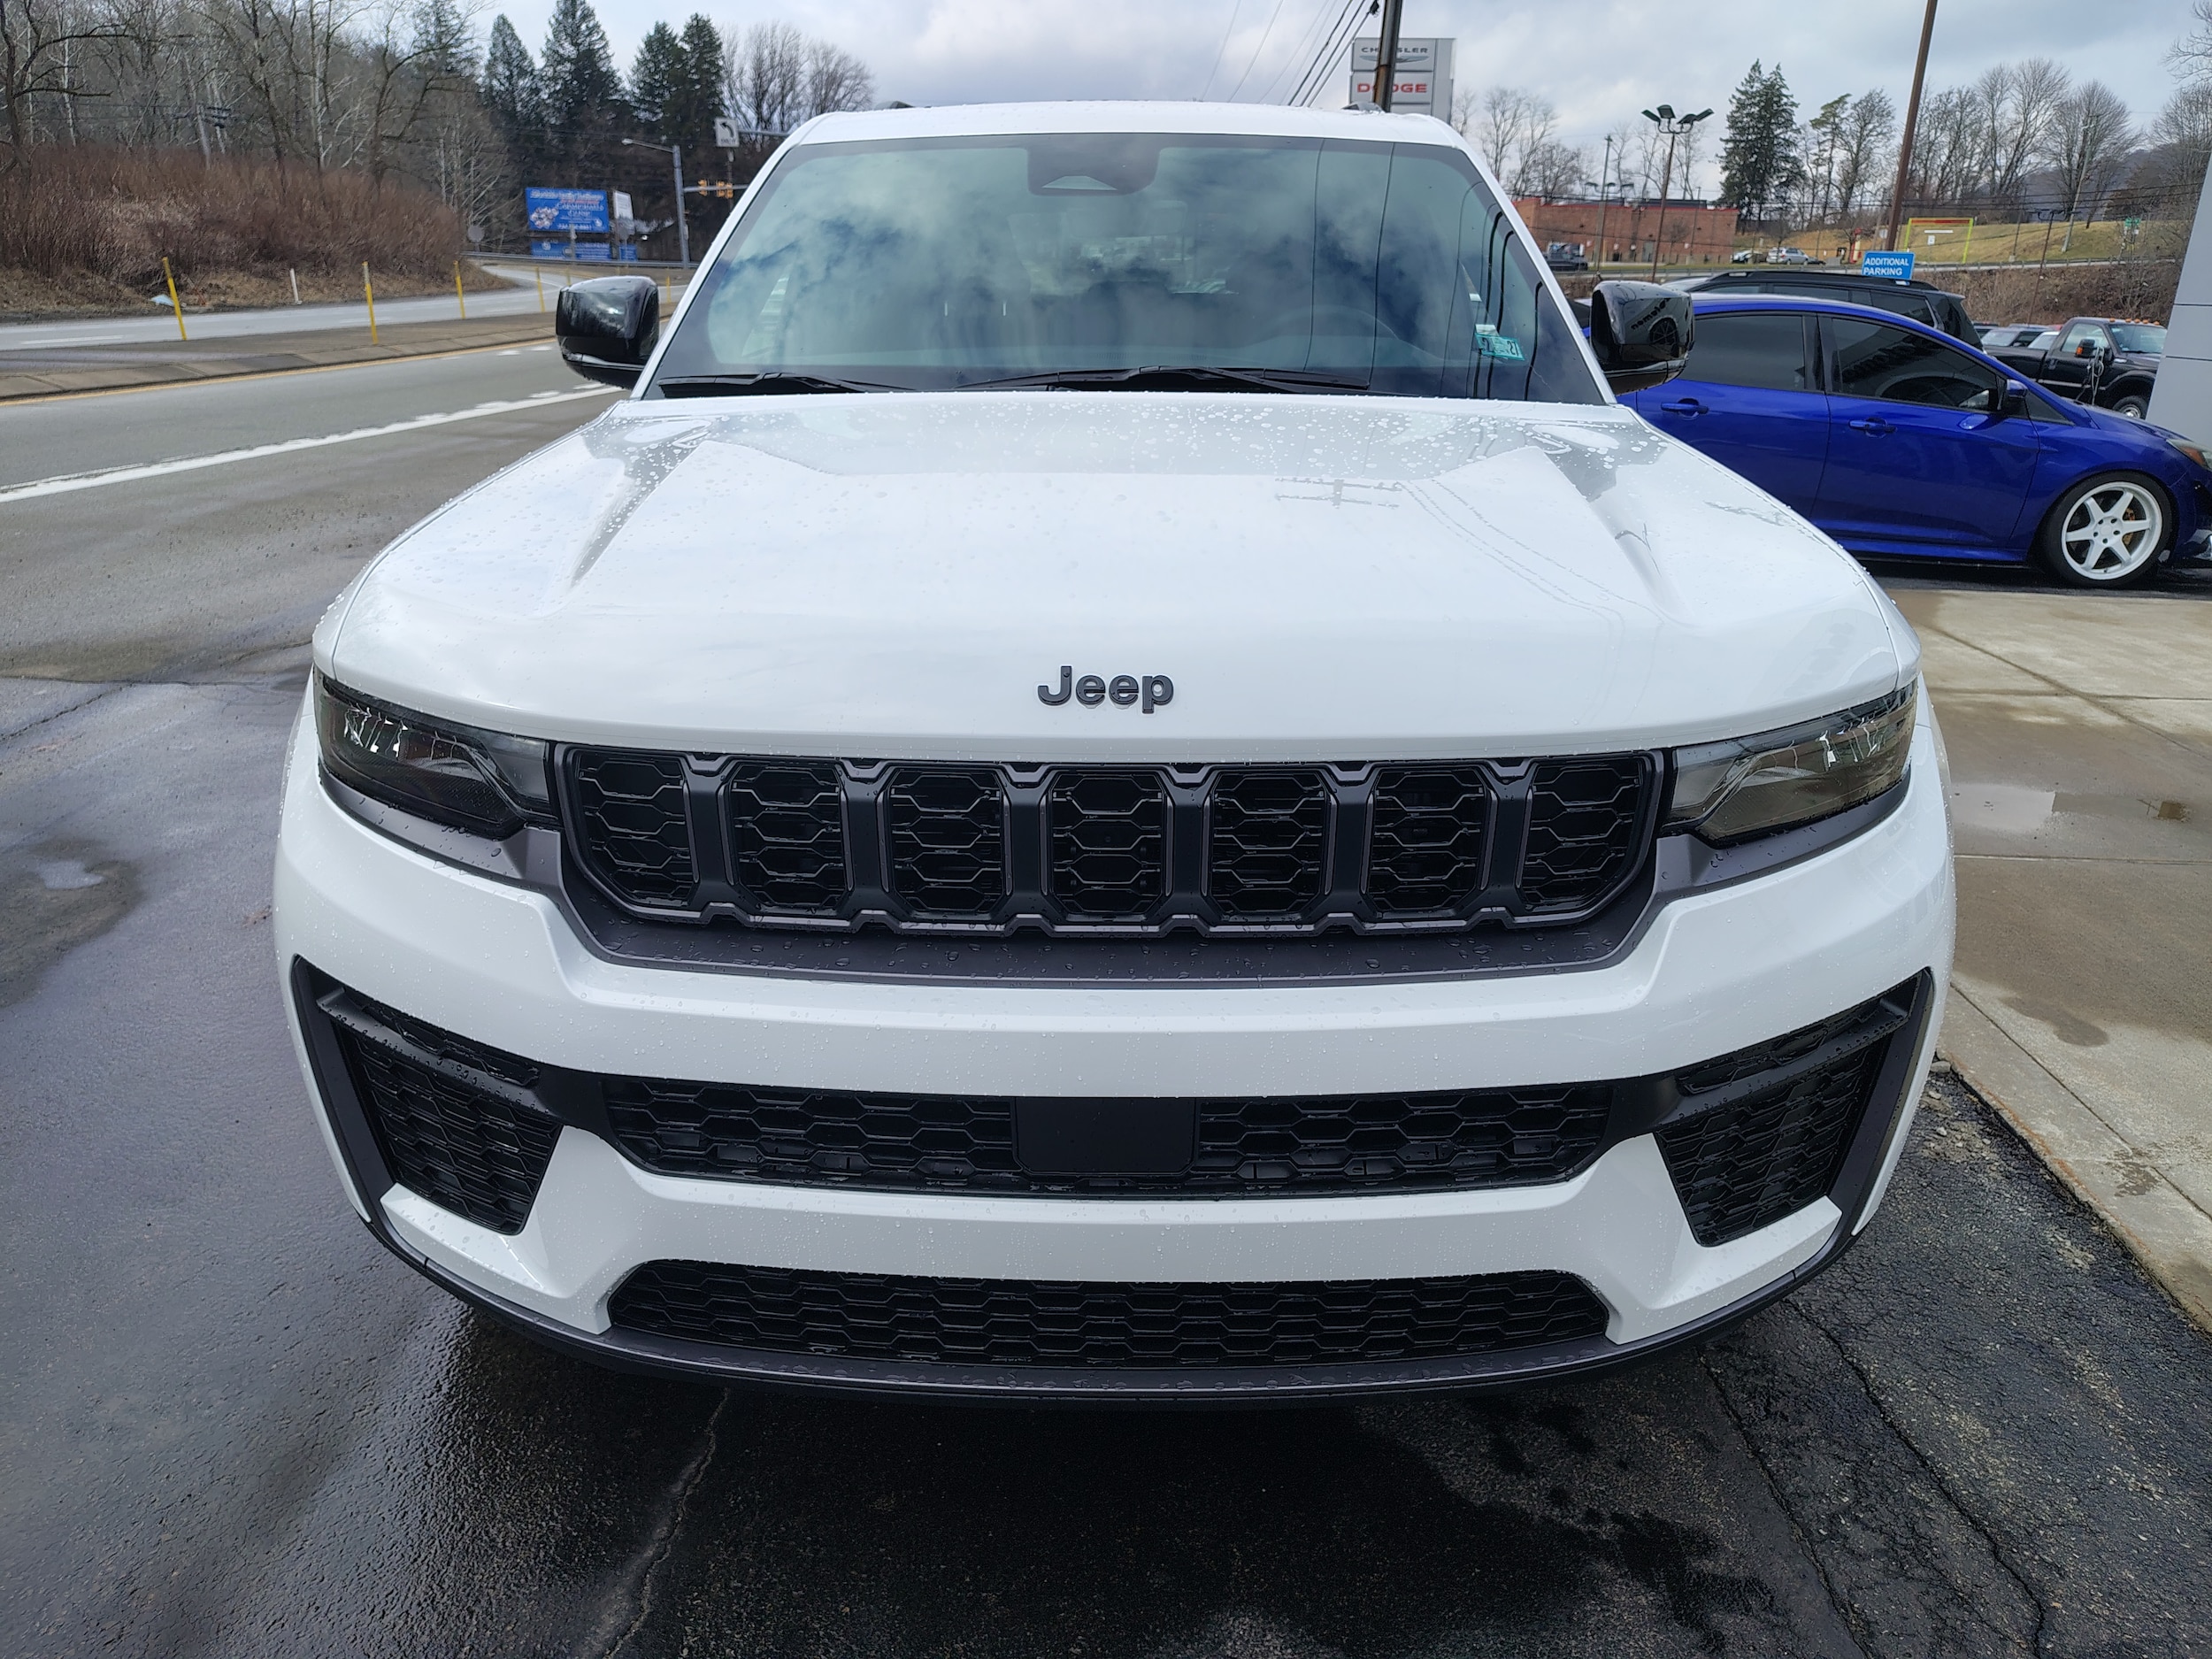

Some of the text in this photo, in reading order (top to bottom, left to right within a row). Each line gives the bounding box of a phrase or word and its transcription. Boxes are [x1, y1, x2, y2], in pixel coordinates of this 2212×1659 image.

[1356, 83, 1427, 93] DGE
[1864, 257, 1909, 266] ADDITIONAL
[1863, 266, 1902, 276] PARKING
[1037, 665, 1174, 714] Jeep
